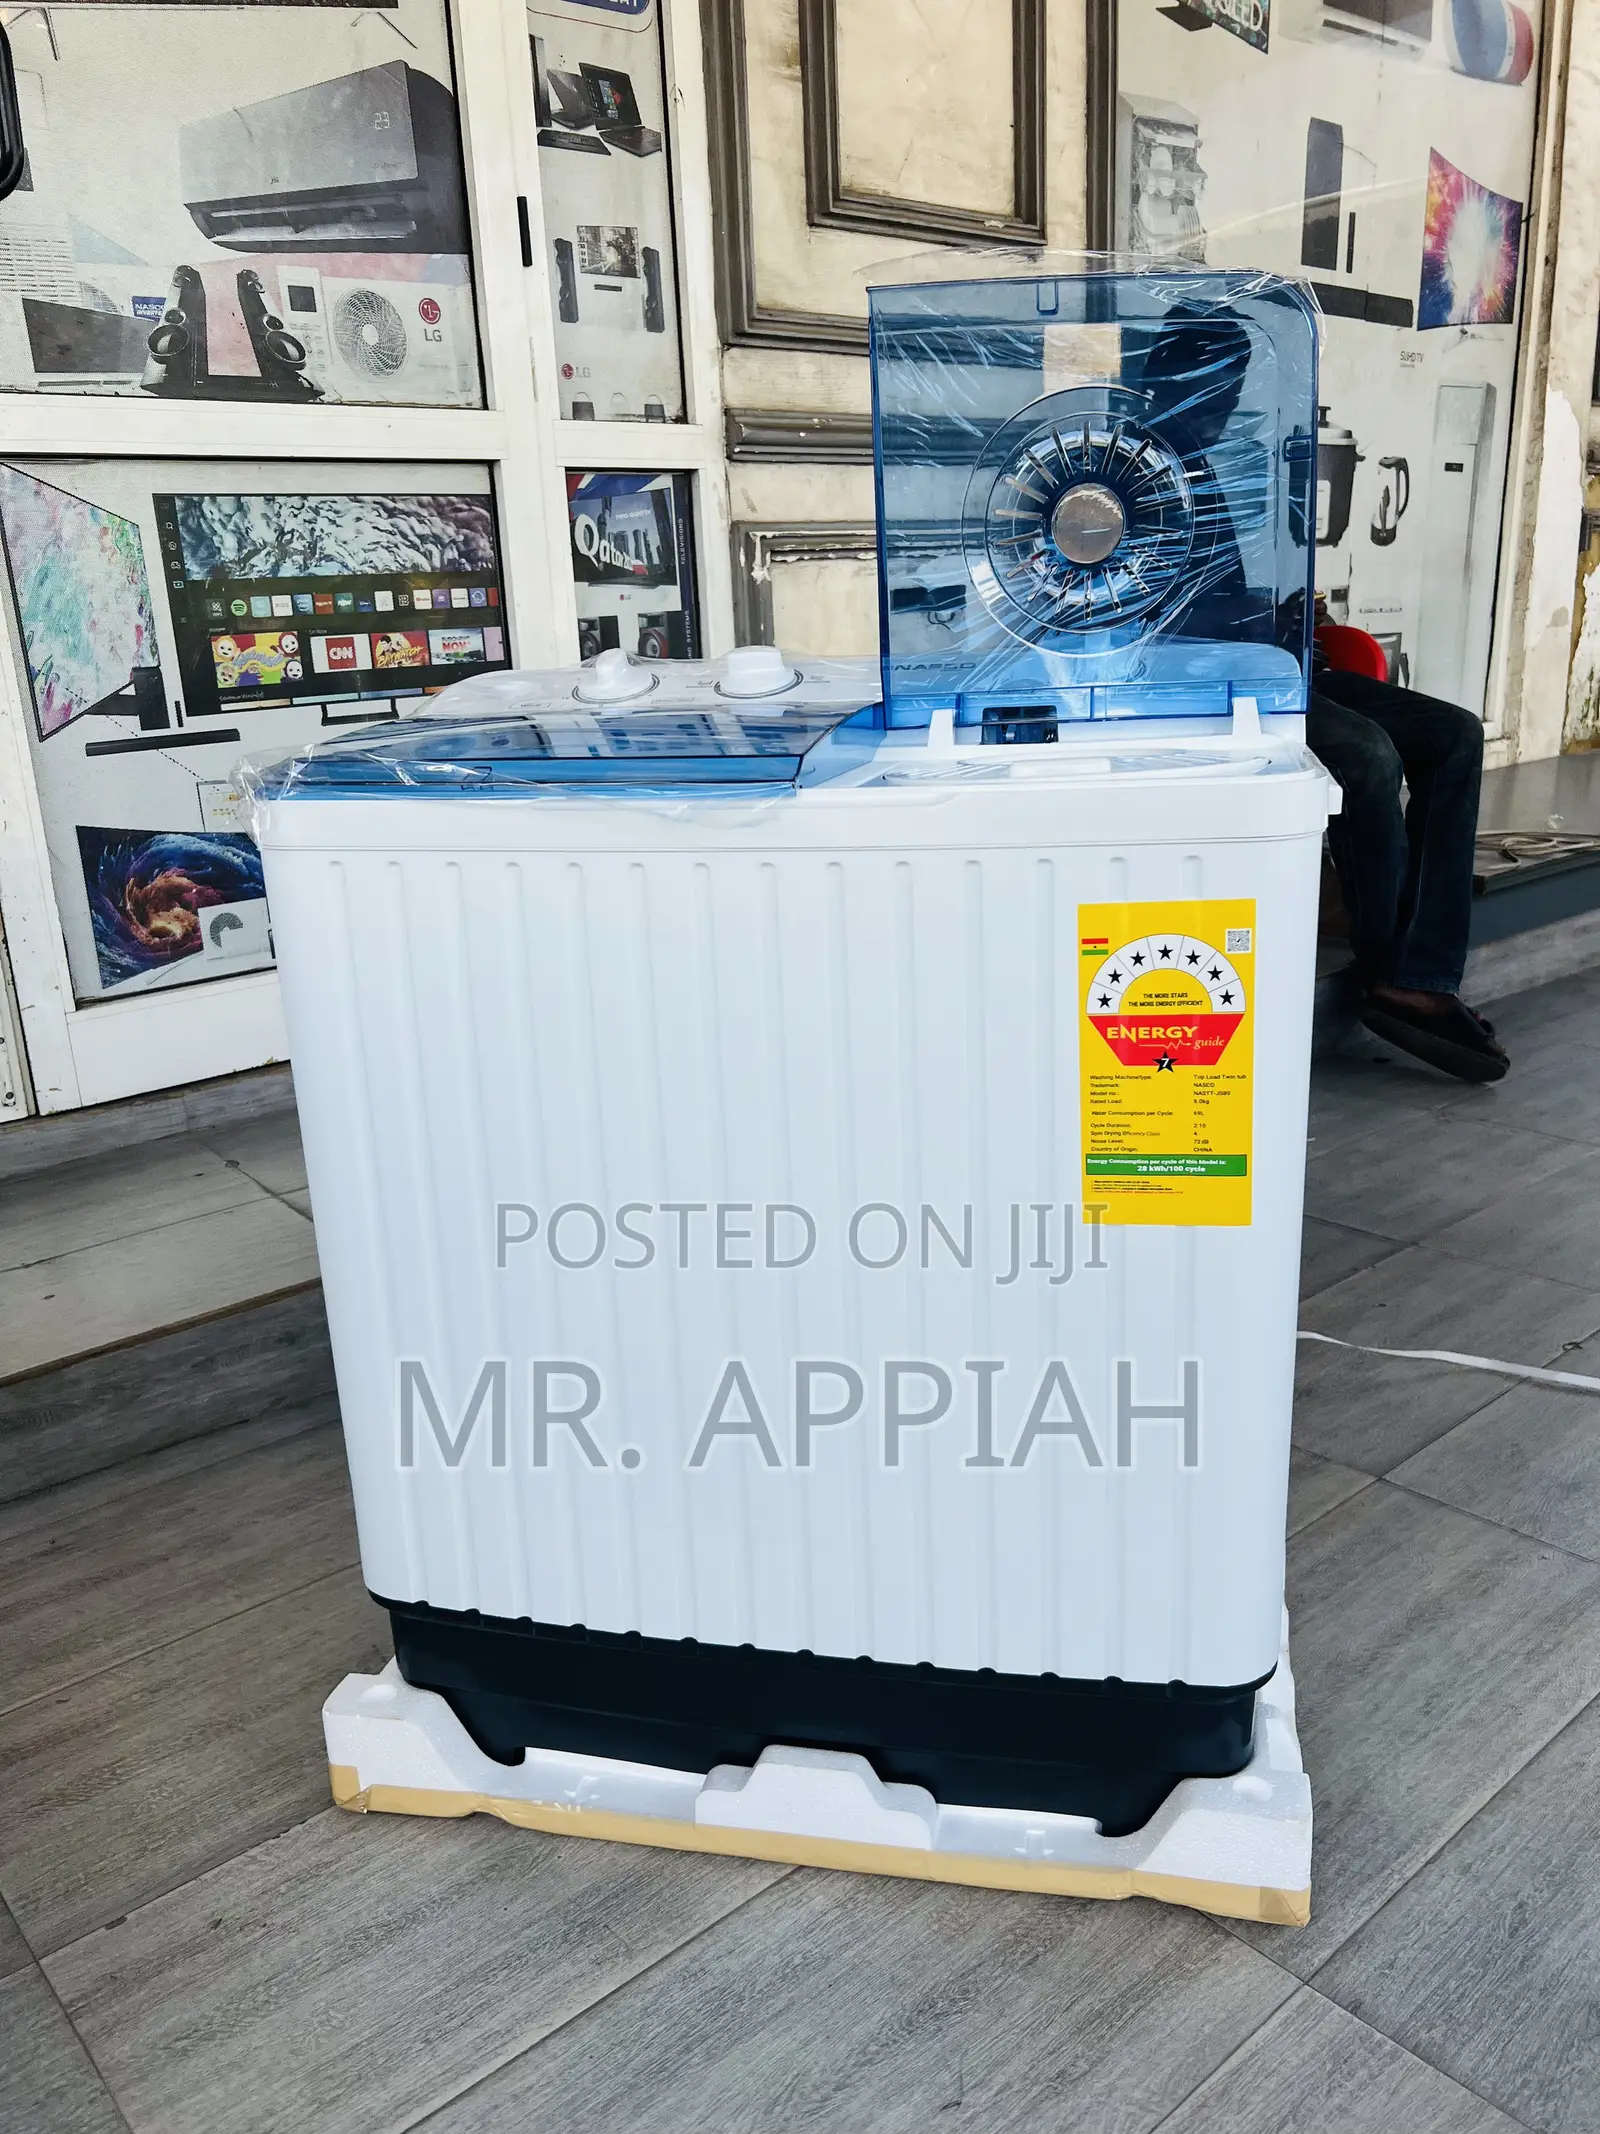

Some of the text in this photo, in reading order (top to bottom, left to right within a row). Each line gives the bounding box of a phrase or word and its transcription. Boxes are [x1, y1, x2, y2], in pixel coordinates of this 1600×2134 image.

[423, 328, 442, 342] LG
[575, 366, 591, 378] LG
[329, 646, 354, 661] CNN
[376, 645, 425, 668] BAYWATCH
[1107, 1024, 1198, 1043] ENERGY
[1194, 1035, 1225, 1050] guide
[1160, 1057, 1170, 1068] 7
